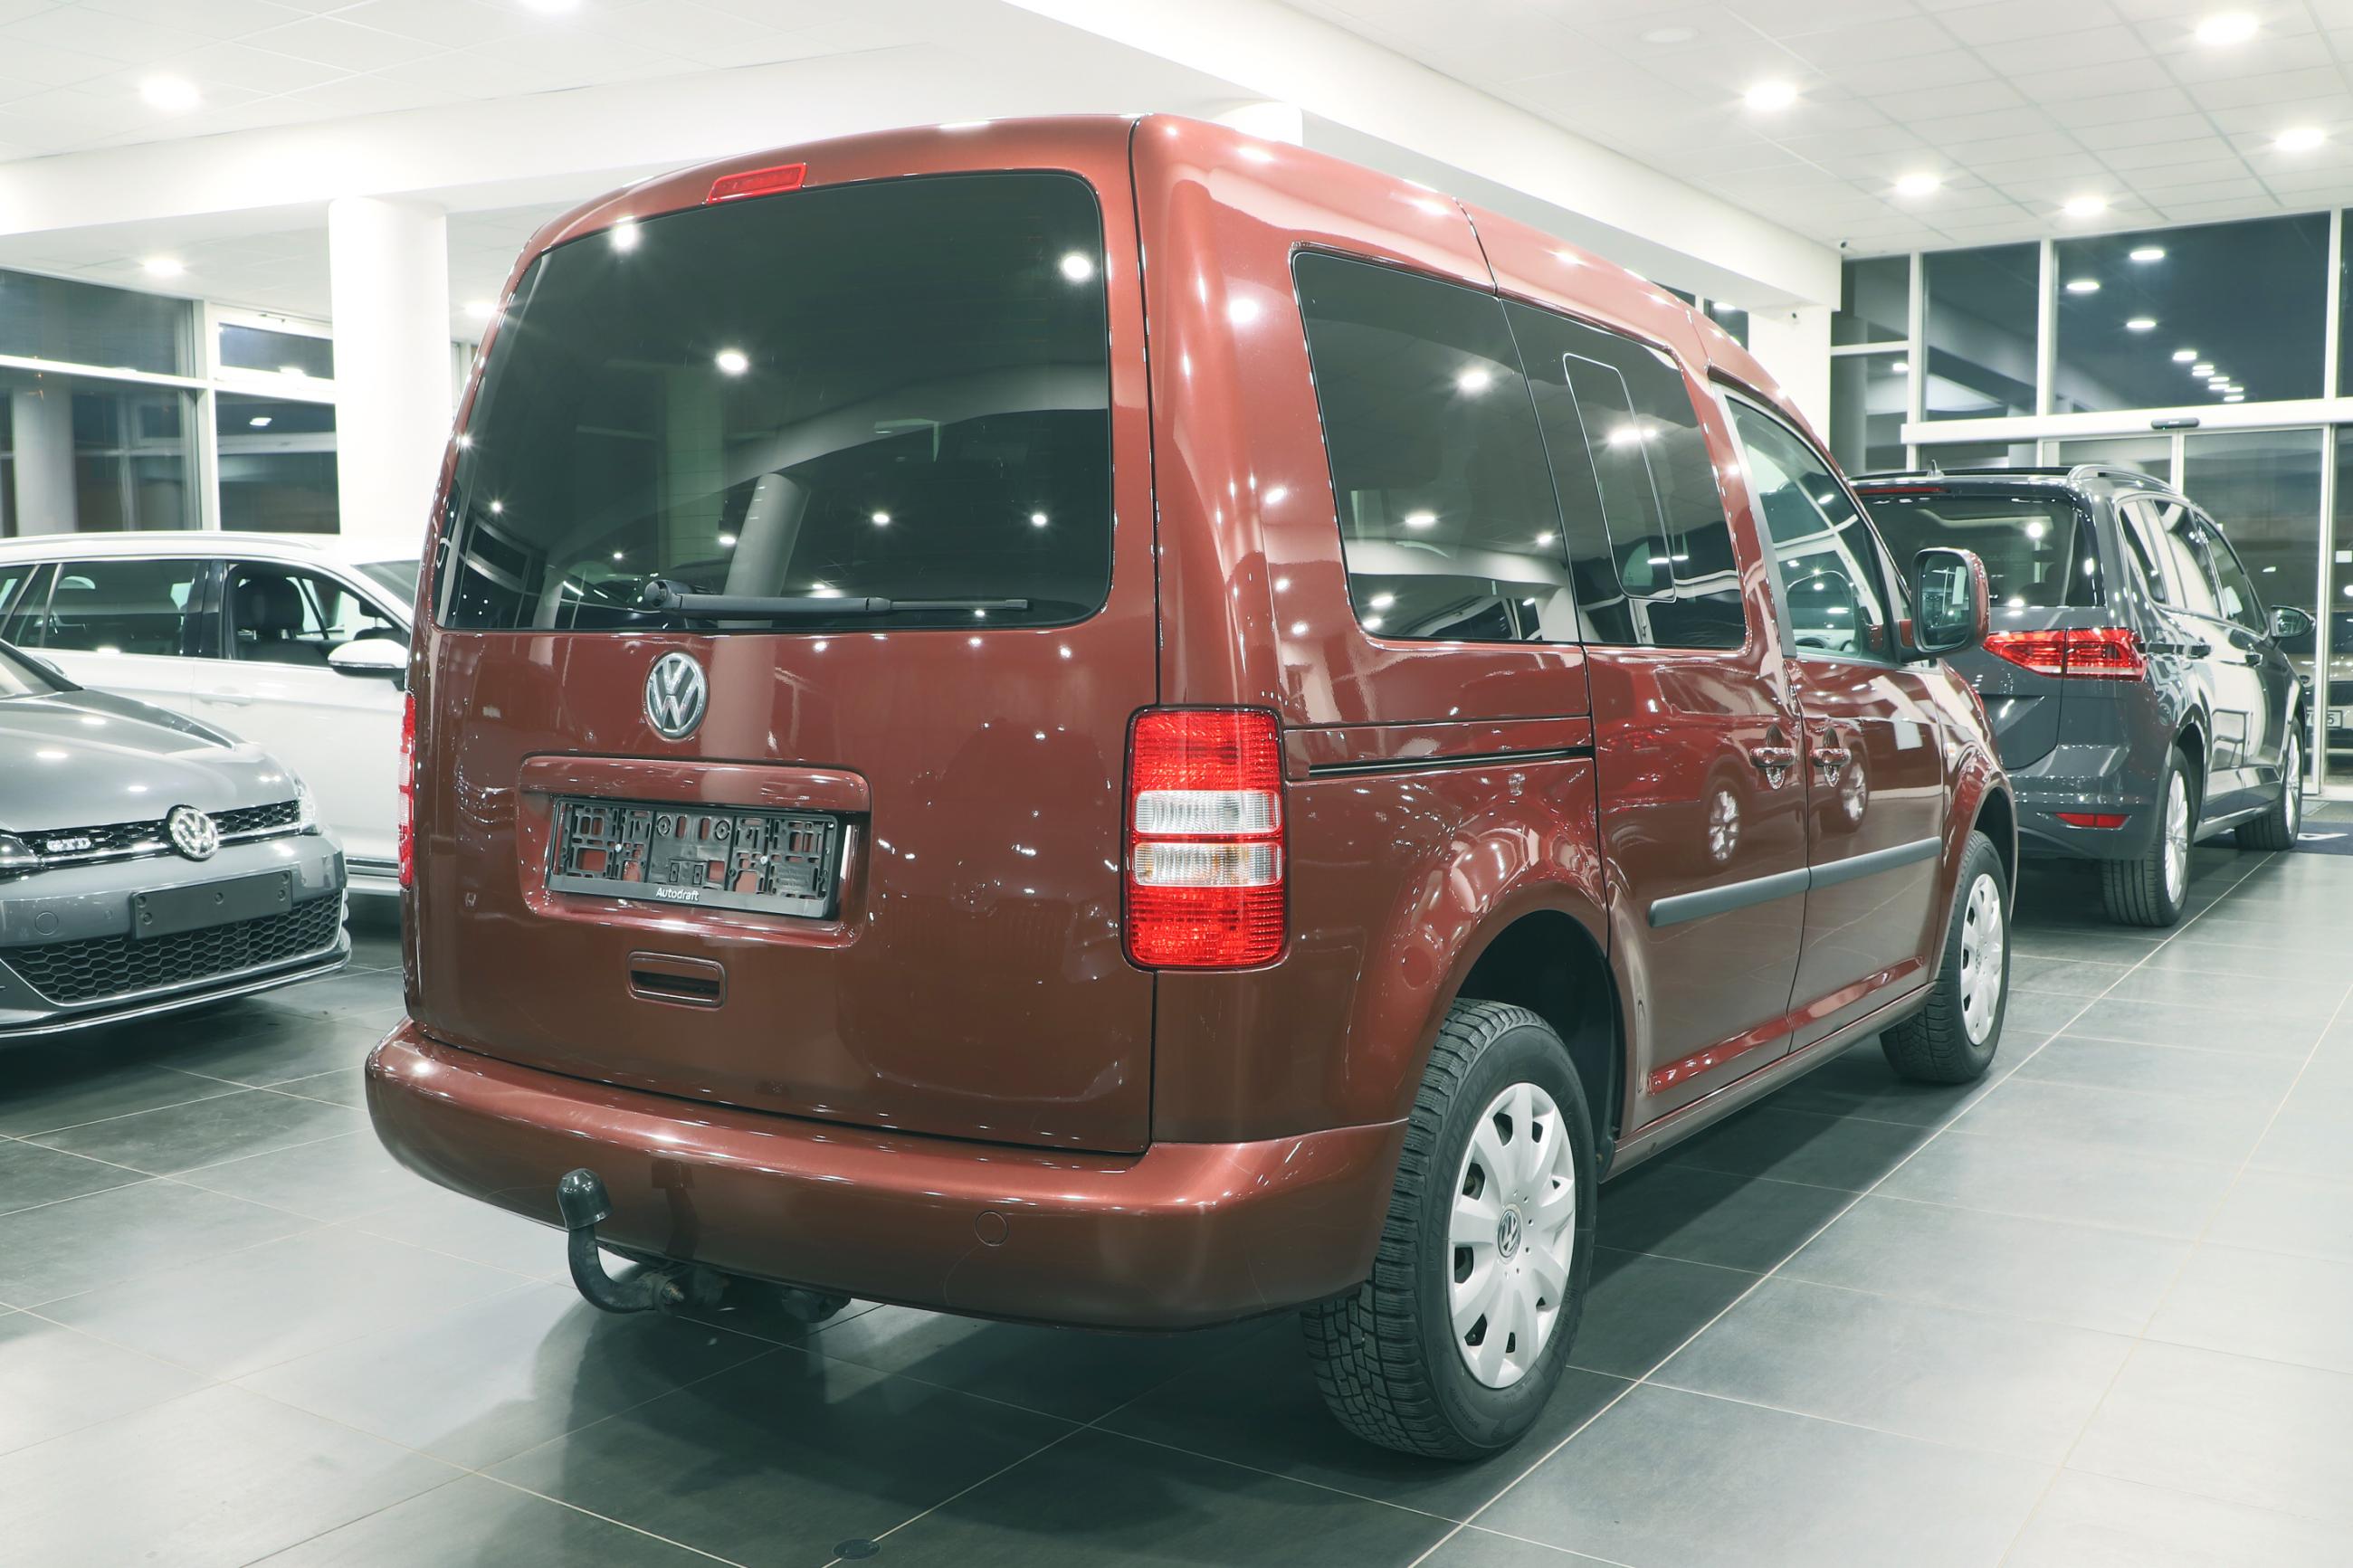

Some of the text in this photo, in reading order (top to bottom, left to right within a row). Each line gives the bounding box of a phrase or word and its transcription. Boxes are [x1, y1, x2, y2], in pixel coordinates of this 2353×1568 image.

[647, 653, 707, 735] VW
[46, 838, 91, 852] GTD
[171, 808, 218, 859] VW
[655, 887, 700, 901] Autodraft
[1498, 1210, 1519, 1257] VW
